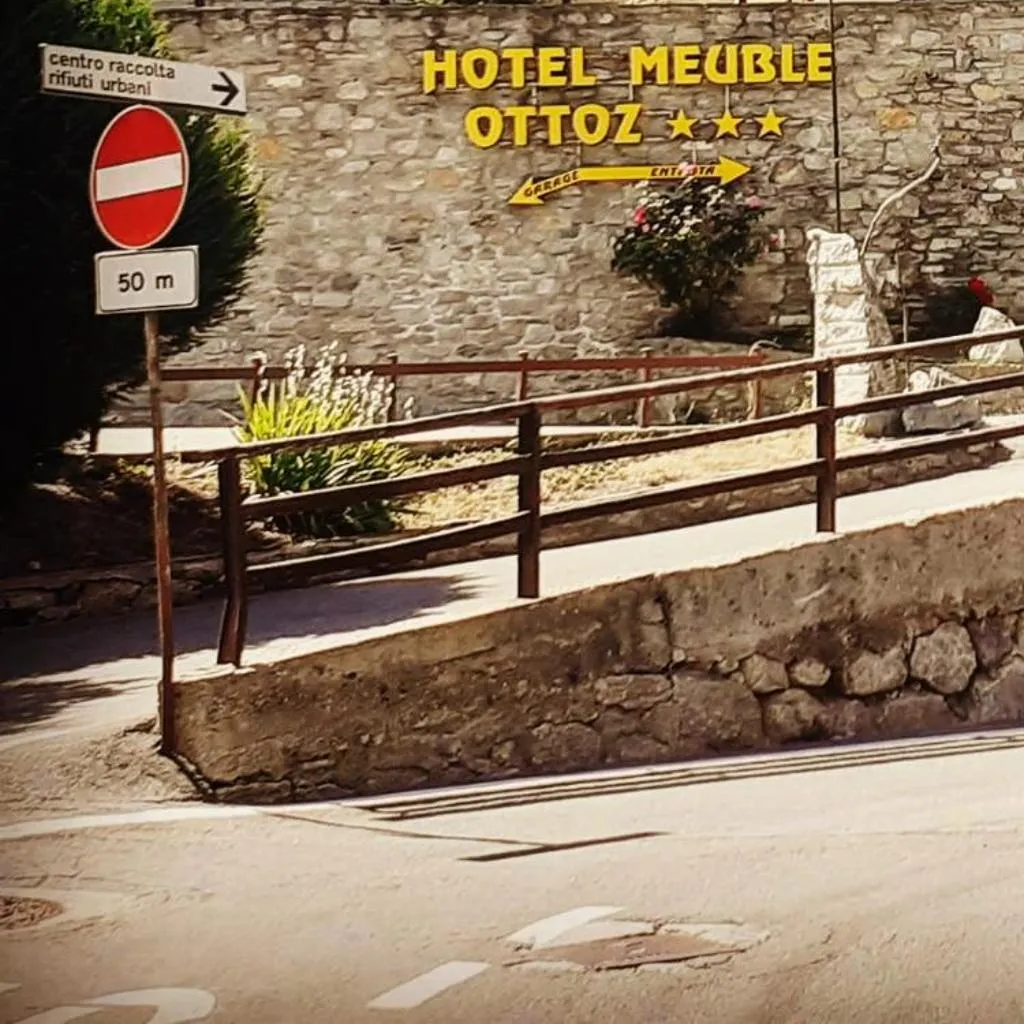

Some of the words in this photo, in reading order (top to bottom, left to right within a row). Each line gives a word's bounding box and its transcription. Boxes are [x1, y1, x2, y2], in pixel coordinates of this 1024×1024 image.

[49, 50, 104, 71] centro
[109, 60, 176, 79] raccolta
[422, 47, 597, 93] HOTEL
[628, 43, 834, 86] MEUBLE
[49, 70, 94, 89] rifiuti
[100, 77, 152, 96] urbani
[464, 103, 643, 148] OTTOZ
[523, 170, 579, 197] GARAGE
[651, 166, 716, 177] ENTTA
[118, 272, 145, 293] 50
[155, 273, 174, 289] m
